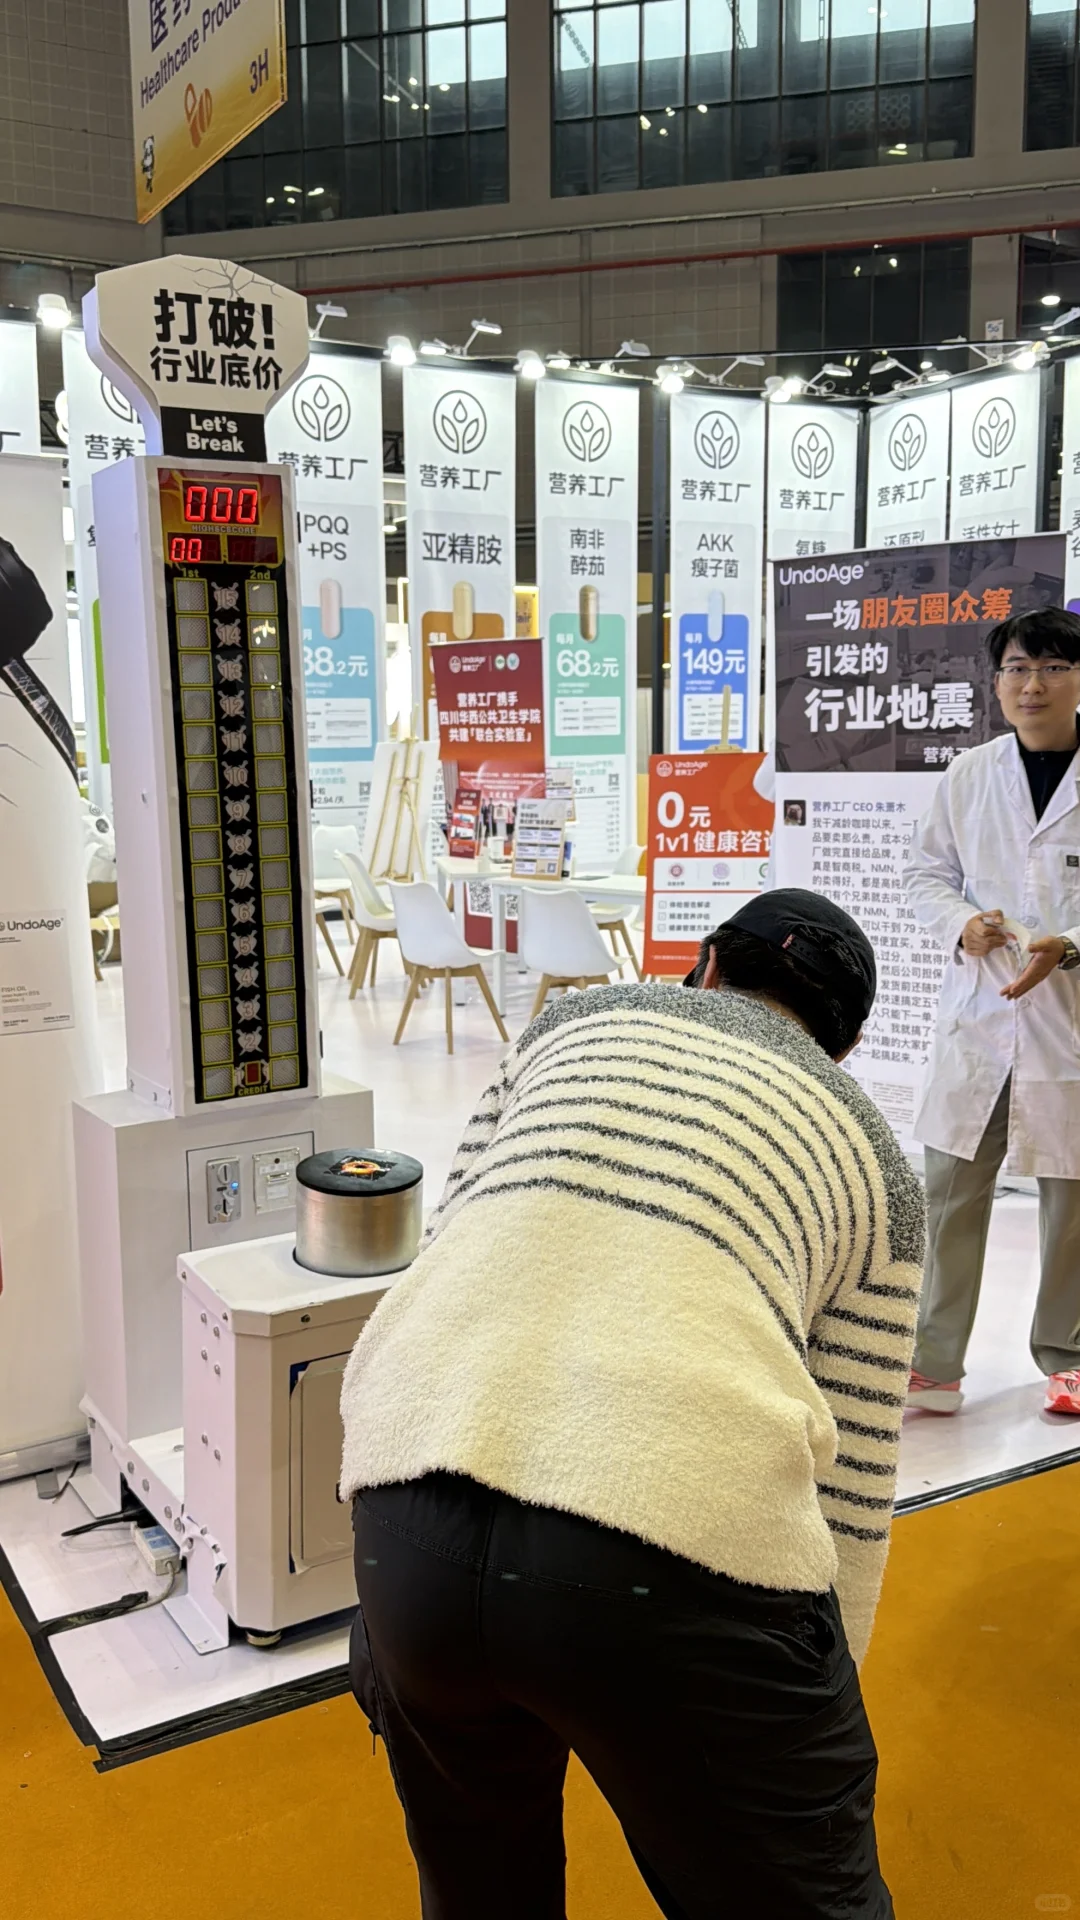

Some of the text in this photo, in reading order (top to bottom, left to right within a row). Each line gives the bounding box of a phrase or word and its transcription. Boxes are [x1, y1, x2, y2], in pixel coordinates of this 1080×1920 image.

[140, 28, 200, 109] Healthcare
[249, 48, 269, 94] 3H
[150, 345, 283, 391] 行业底价
[84, 434, 146, 460] 营养
[186, 432, 245, 453] Break
[278, 451, 368, 480] 营养工厂
[420, 464, 502, 491] 营养工厂
[549, 472, 625, 497] 营养工厂
[959, 464, 1027, 497] 营养工厂
[681, 479, 751, 503] 营养工厂
[779, 488, 845, 511] 营养工厂
[877, 477, 937, 507] 营养工厂
[185, 486, 258, 523] 000
[303, 514, 349, 536] PQQ
[422, 532, 502, 565] 亚精胺
[570, 527, 605, 550] 南非
[696, 533, 734, 553] AKK
[170, 537, 202, 563] 00
[307, 541, 348, 561] +PS
[182, 568, 200, 578] 1st
[249, 570, 271, 580] 2nd
[570, 555, 605, 576] 醉茄
[691, 557, 740, 579] 瘦子菌
[215, 592, 236, 606] 15
[805, 587, 1013, 631] 一场朋友圈众筹
[219, 629, 239, 643] 14
[556, 649, 620, 678] 68.2元
[682, 648, 746, 676] 149元
[806, 643, 889, 677] 引发的
[221, 664, 241, 679] 13
[225, 699, 244, 714] 12
[457, 691, 518, 708] 营养工厂携手
[804, 682, 974, 732] 行业地震
[439, 708, 541, 725] 四川华西公共卫生学院
[226, 769, 248, 784] 10
[232, 804, 243, 818] 9
[812, 801, 851, 812] 营养工厂
[853, 802, 873, 812] CEO
[234, 836, 246, 851] 8
[656, 833, 688, 852] 1v1
[235, 871, 247, 887] 7
[238, 905, 250, 920] 6
[7, 918, 61, 931] UndoAge
[903, 924, 917, 933] 79
[239, 938, 250, 953] 5
[870, 935, 947, 950] 想便宜买，发起
[241, 969, 252, 984] 4
[881, 964, 942, 979] 然后公司担保
[242, 1002, 254, 1017] 3
[244, 1033, 256, 1050] 2
[238, 1085, 268, 1096] CREDIT
